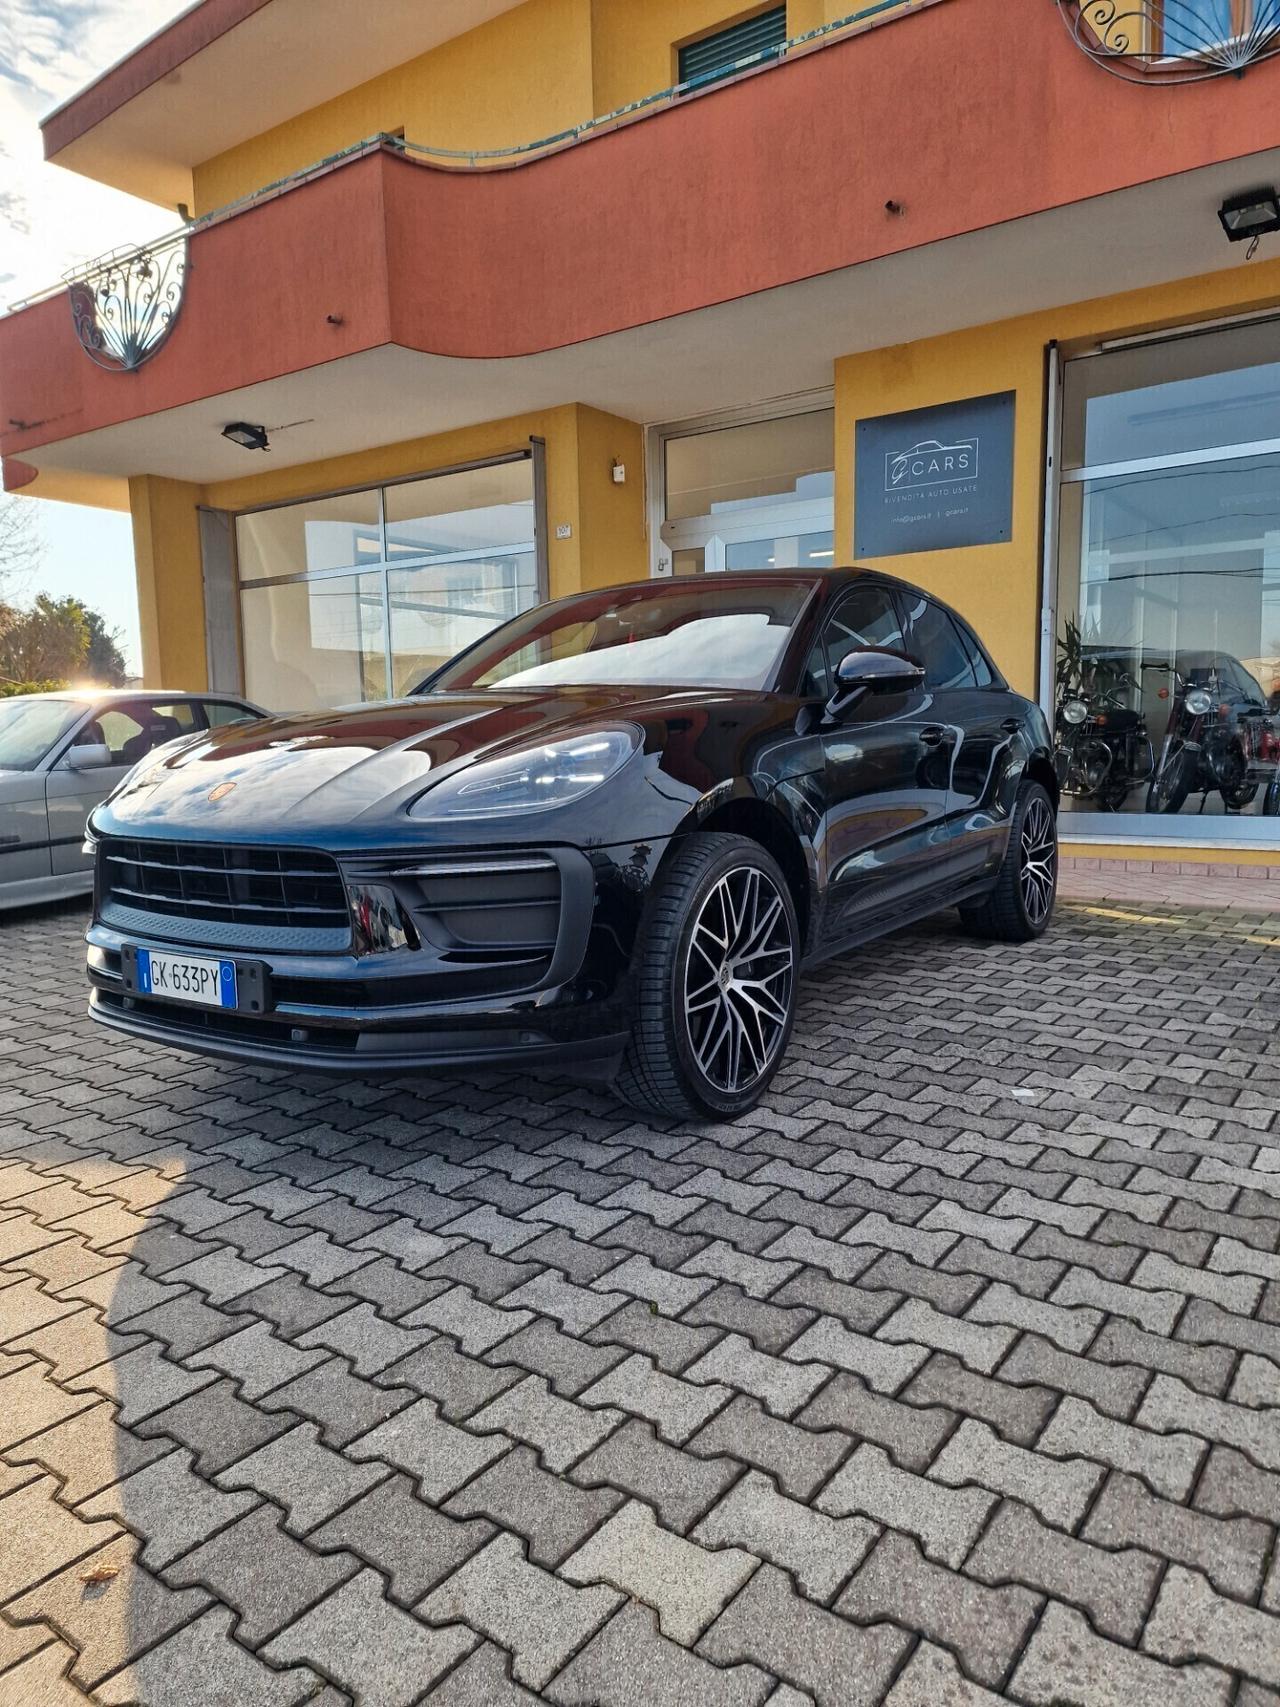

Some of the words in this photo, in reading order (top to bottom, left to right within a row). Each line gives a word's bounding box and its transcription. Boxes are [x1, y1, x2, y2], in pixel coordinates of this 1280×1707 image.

[927, 489, 949, 498] AUTO
[952, 485, 977, 495] USATE
[151, 960, 168, 988] GK
[172, 963, 218, 996] 633PY
